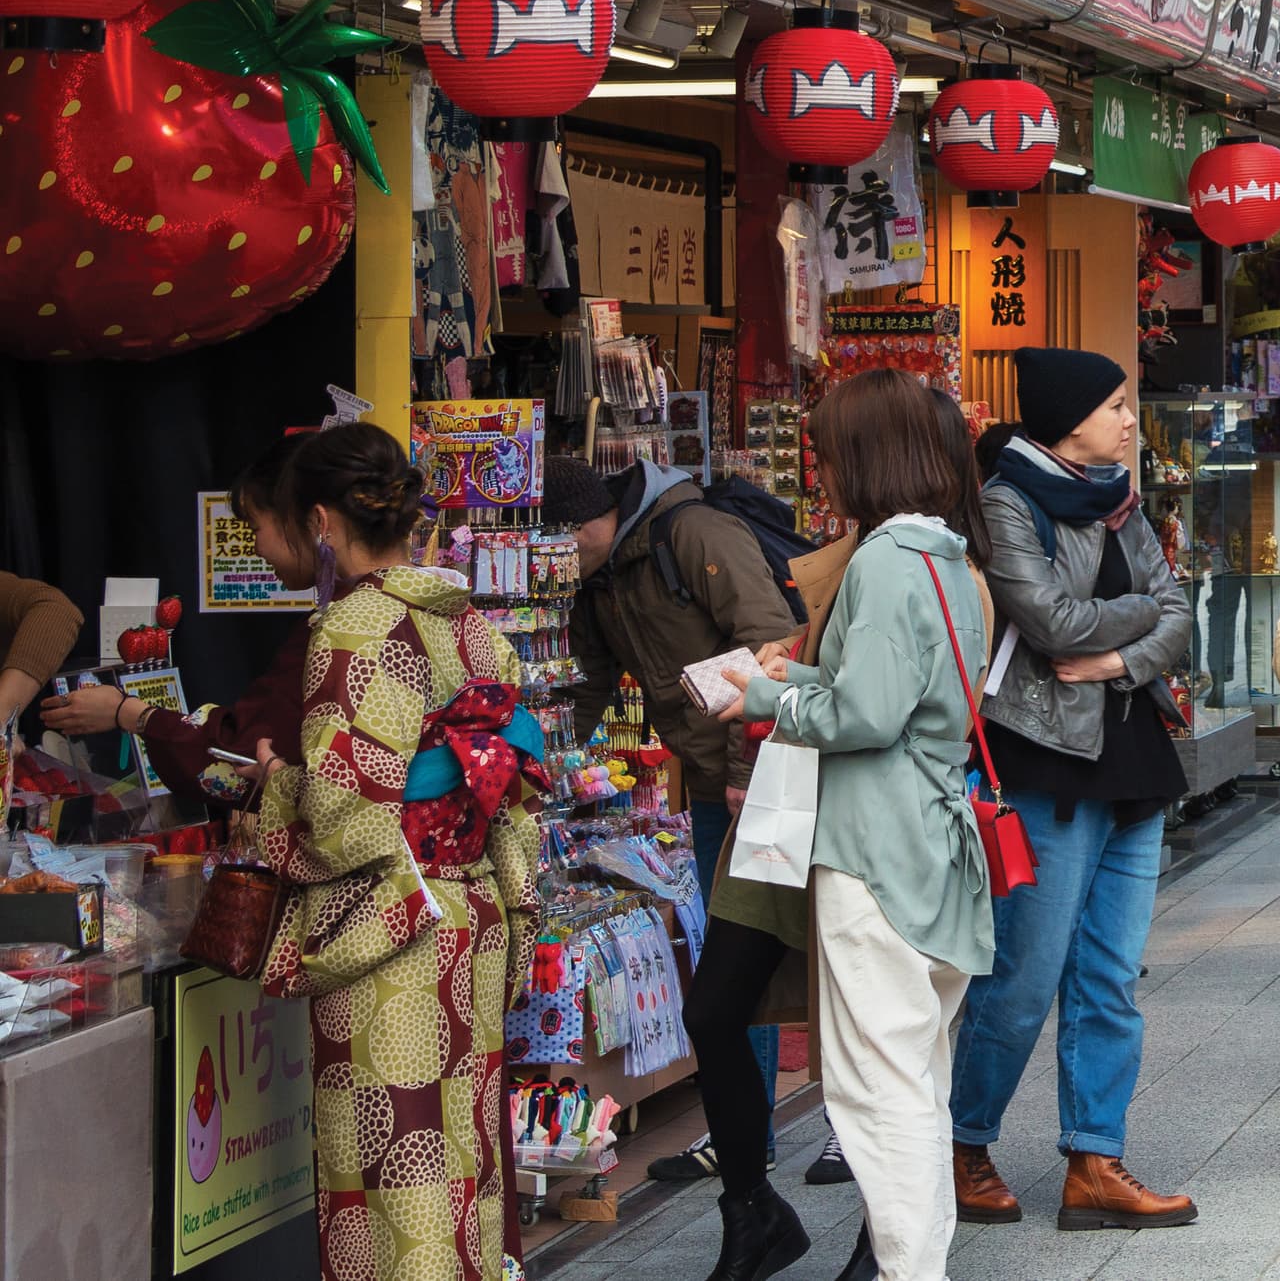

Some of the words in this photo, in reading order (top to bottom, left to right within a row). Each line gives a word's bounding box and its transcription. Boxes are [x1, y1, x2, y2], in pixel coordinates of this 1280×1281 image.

[849, 263, 885, 274] SAMURAI
[431, 412, 480, 433] DRAGON
[225, 1119, 294, 1167] STRAWBERRY
[183, 1211, 201, 1237] Rice
[203, 1202, 221, 1228] cake
[223, 1188, 252, 1220] stuffed
[253, 1181, 270, 1204] with
